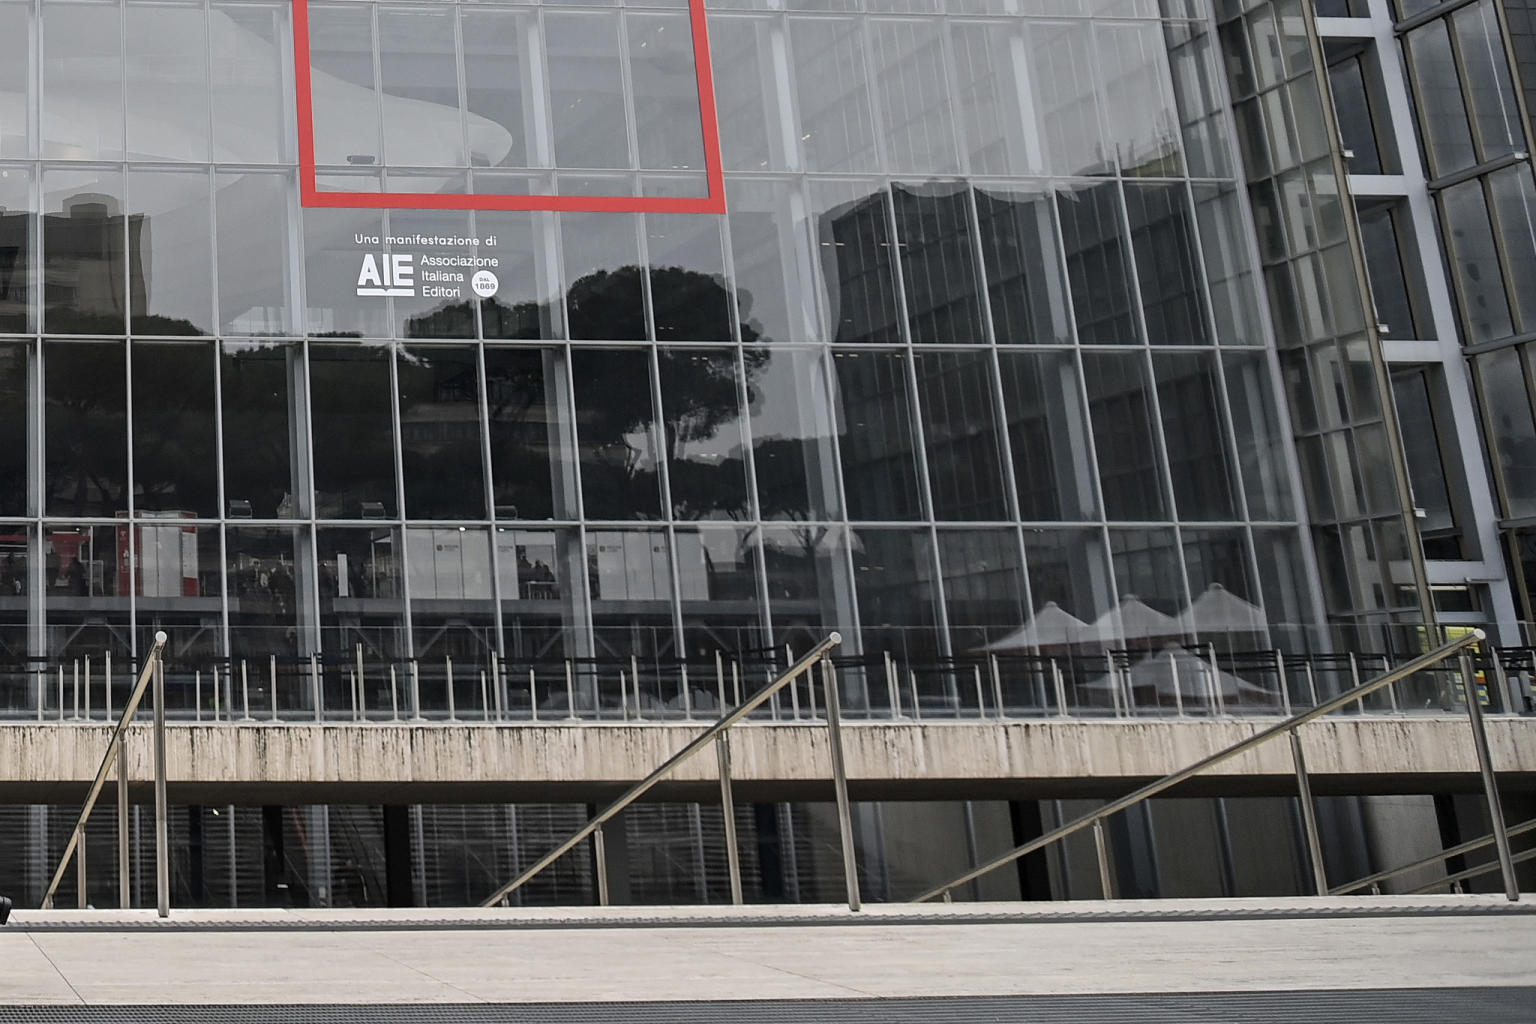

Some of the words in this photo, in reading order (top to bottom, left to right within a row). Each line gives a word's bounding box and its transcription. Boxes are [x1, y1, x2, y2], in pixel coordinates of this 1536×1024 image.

[354, 233, 380, 245] Una
[385, 233, 480, 246] manifestazione
[485, 235, 497, 246] di
[420, 254, 499, 267] Associazione
[357, 253, 414, 287] AIE
[421, 270, 464, 282] Italiana
[422, 285, 461, 298] Editori
